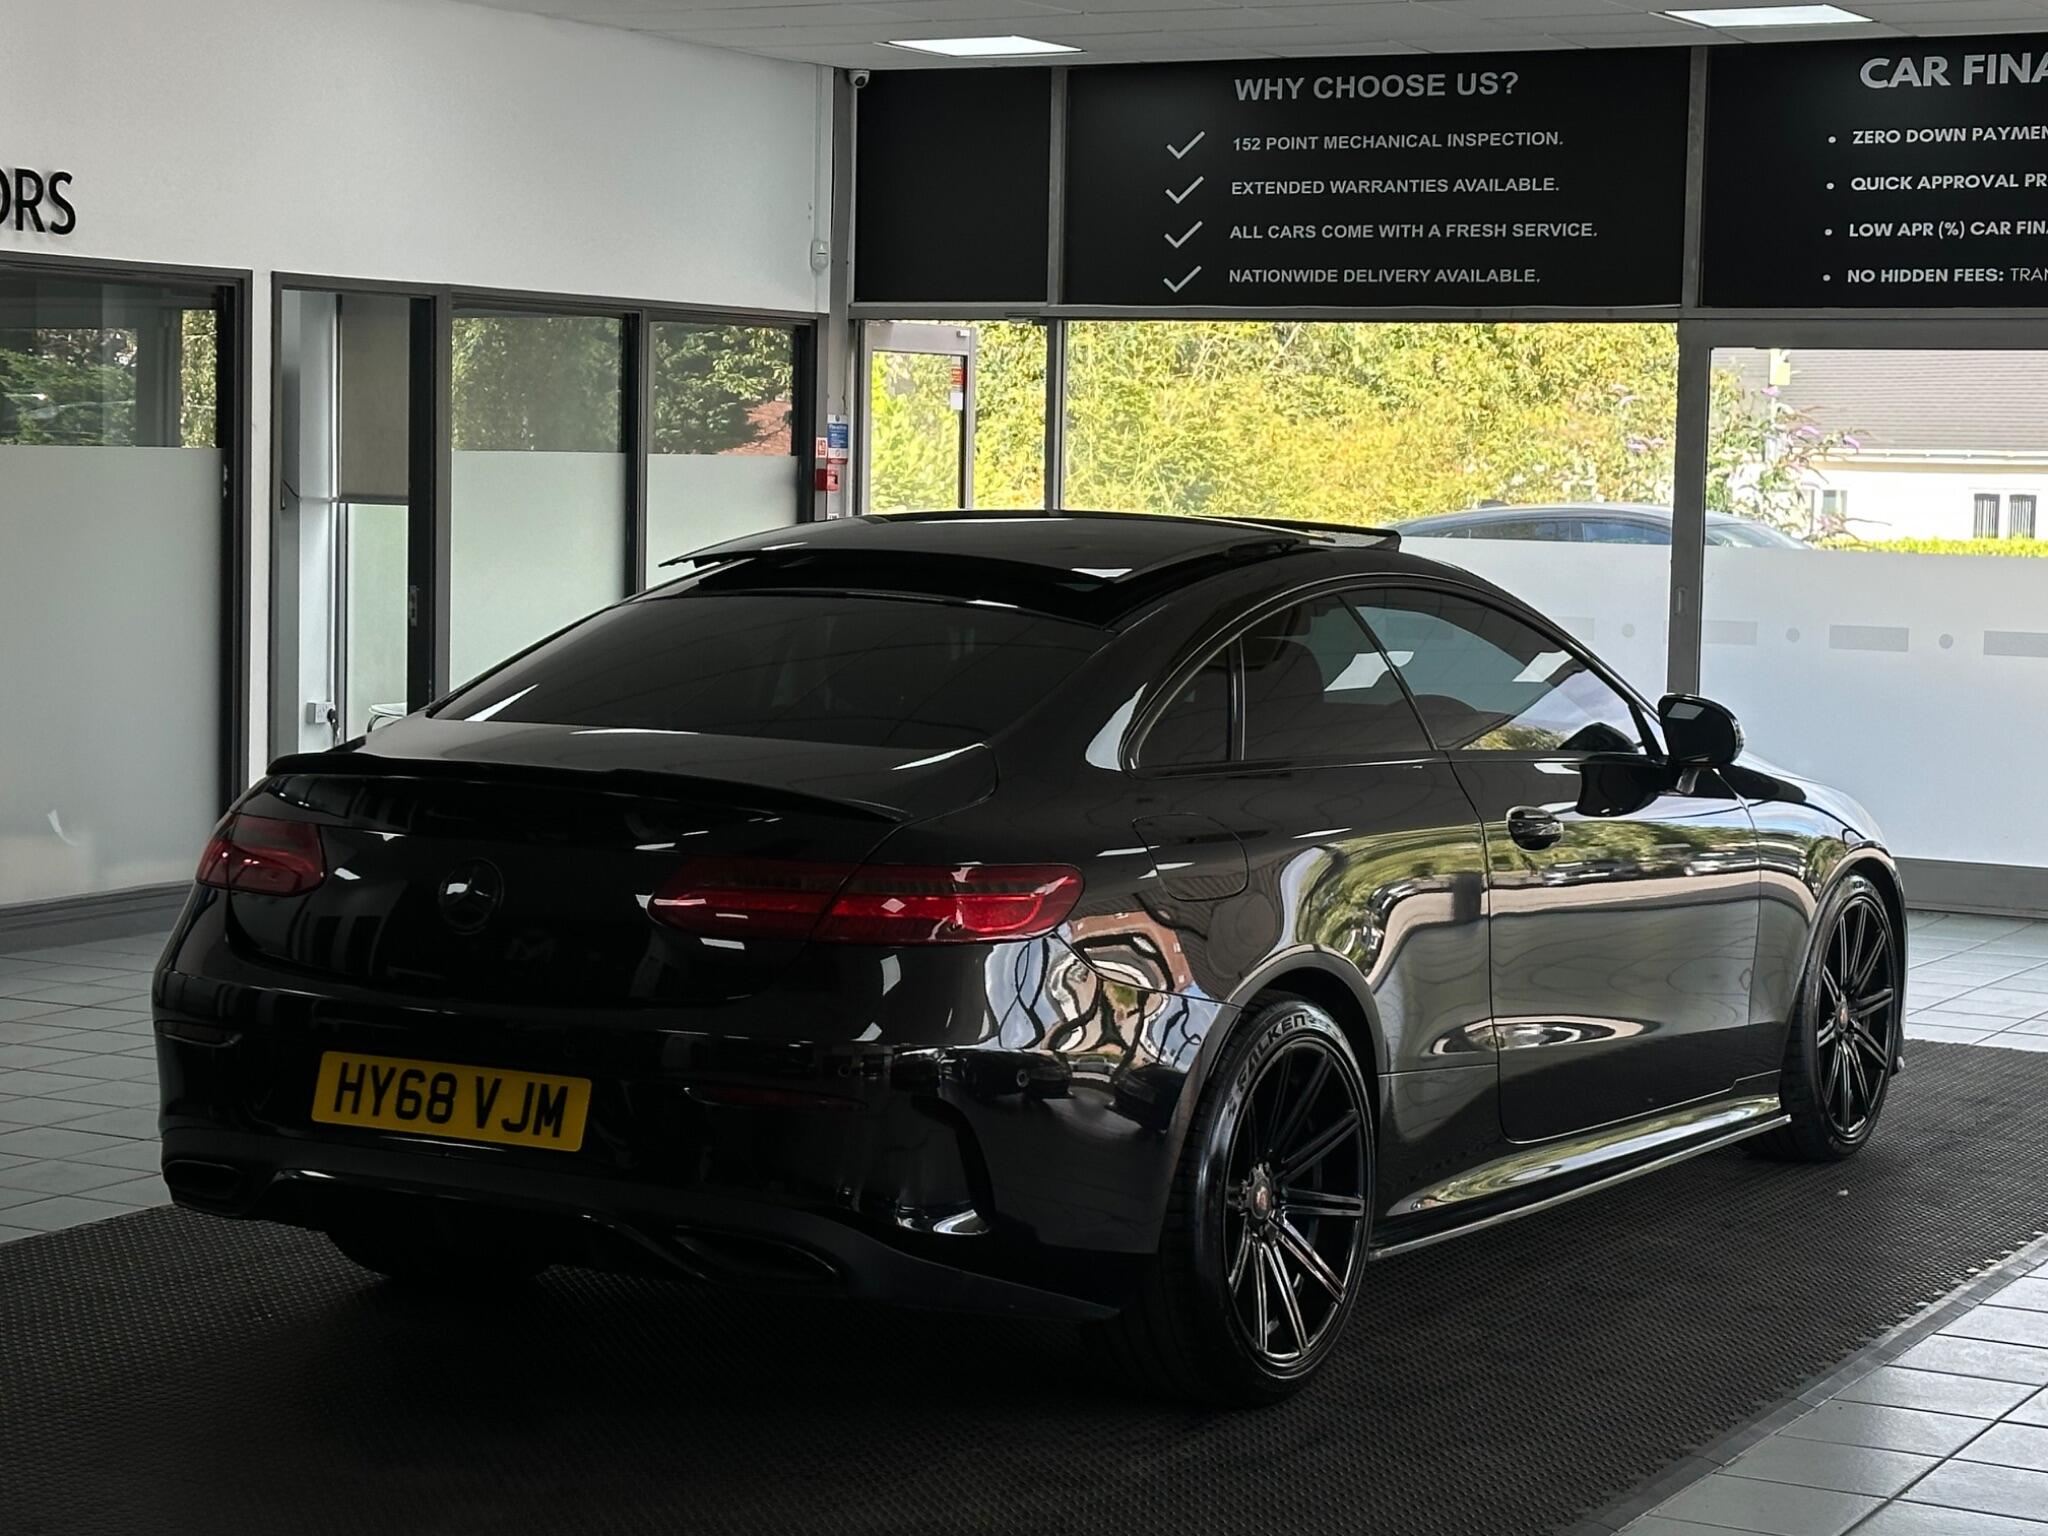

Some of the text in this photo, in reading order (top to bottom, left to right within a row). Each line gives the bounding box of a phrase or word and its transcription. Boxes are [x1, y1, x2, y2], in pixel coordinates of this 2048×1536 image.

[1859, 55, 1952, 89] CAR
[1234, 71, 1519, 101] WHY CHOOSE US?
[1233, 131, 1564, 152] 152 POINT MECHANICAL INSPECTION.
[1852, 129, 1902, 145] ZERO
[1905, 127, 1967, 144] DOWN
[1231, 177, 1560, 195] EXTENDED WARRANTIES AVAILABLE.
[1850, 175, 1913, 192] QUICK
[1916, 173, 2020, 190] APPROVAL
[1229, 222, 1598, 240] ALL CARS COME WITH A FRESH SERVICE.
[1849, 220, 2048, 240] LOW APR (%) CAR FIN
[1229, 268, 1541, 284] NATIONWIDE DELIVERY AVAILABLE.
[1847, 268, 1876, 284] NO
[1880, 268, 1949, 283] HIDDEN
[1953, 267, 2005, 283] FEES:
[333, 1061, 569, 1138] HY68 VJM
